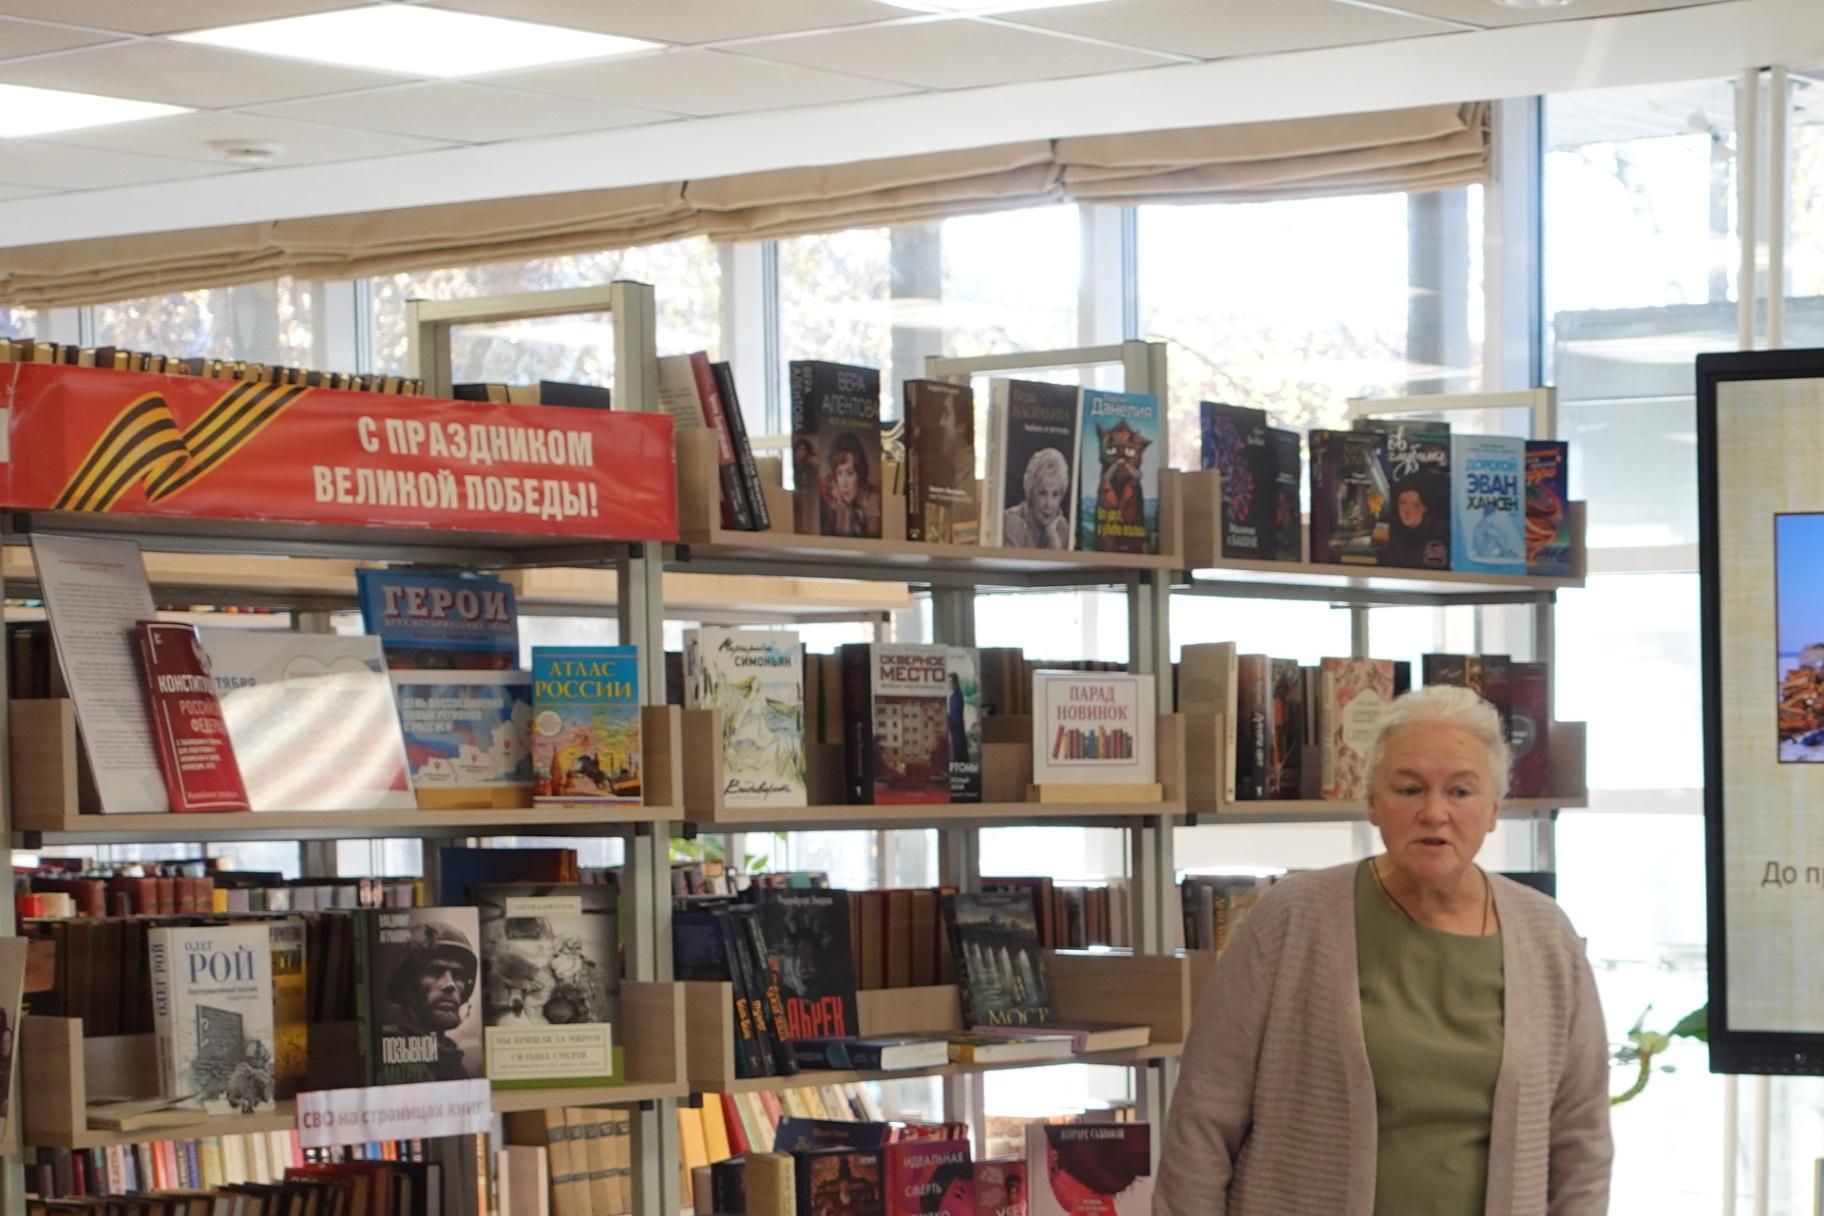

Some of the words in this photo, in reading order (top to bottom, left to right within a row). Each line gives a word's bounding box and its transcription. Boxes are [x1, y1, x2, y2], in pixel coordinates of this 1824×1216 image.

[1090, 397, 1153, 418] Данелия
[357, 416, 380, 453] С
[385, 417, 594, 467] ПРАЗДНИКОМ
[313, 465, 459, 510] ВЕЛИКОЙ
[464, 474, 599, 521] ПОБЕДЫ!
[1466, 474, 1518, 496] ЭВАН
[381, 585, 511, 624] ГЕРОИ
[550, 661, 617, 678] АТЛАС
[733, 655, 792, 668] СИМОНЬЯН
[878, 654, 946, 667] СКВЕРНОЕ
[879, 667, 947, 683] МЕСТО
[534, 680, 633, 700] РОССИИ
[1068, 684, 1116, 704] ПАРАД
[1056, 703, 1129, 722] НОВИНОК
[1761, 862, 1797, 888] До
[152, 943, 166, 974] РОЙ
[187, 945, 256, 984] РОЙ
[155, 981, 168, 1017] ОЛЕГ
[786, 995, 845, 1040] АБРЕК
[382, 1031, 438, 1065] ПОЗЫВНОЙ
[303, 1112, 334, 1129] СВО
[338, 1113, 358, 1126] на
[361, 1105, 443, 1127] страницах
[444, 1101, 483, 1117] книг
[903, 1151, 964, 1170] ИДЕАЛЬНАЯ
[904, 1184, 943, 1197] СМЕРТЬ
